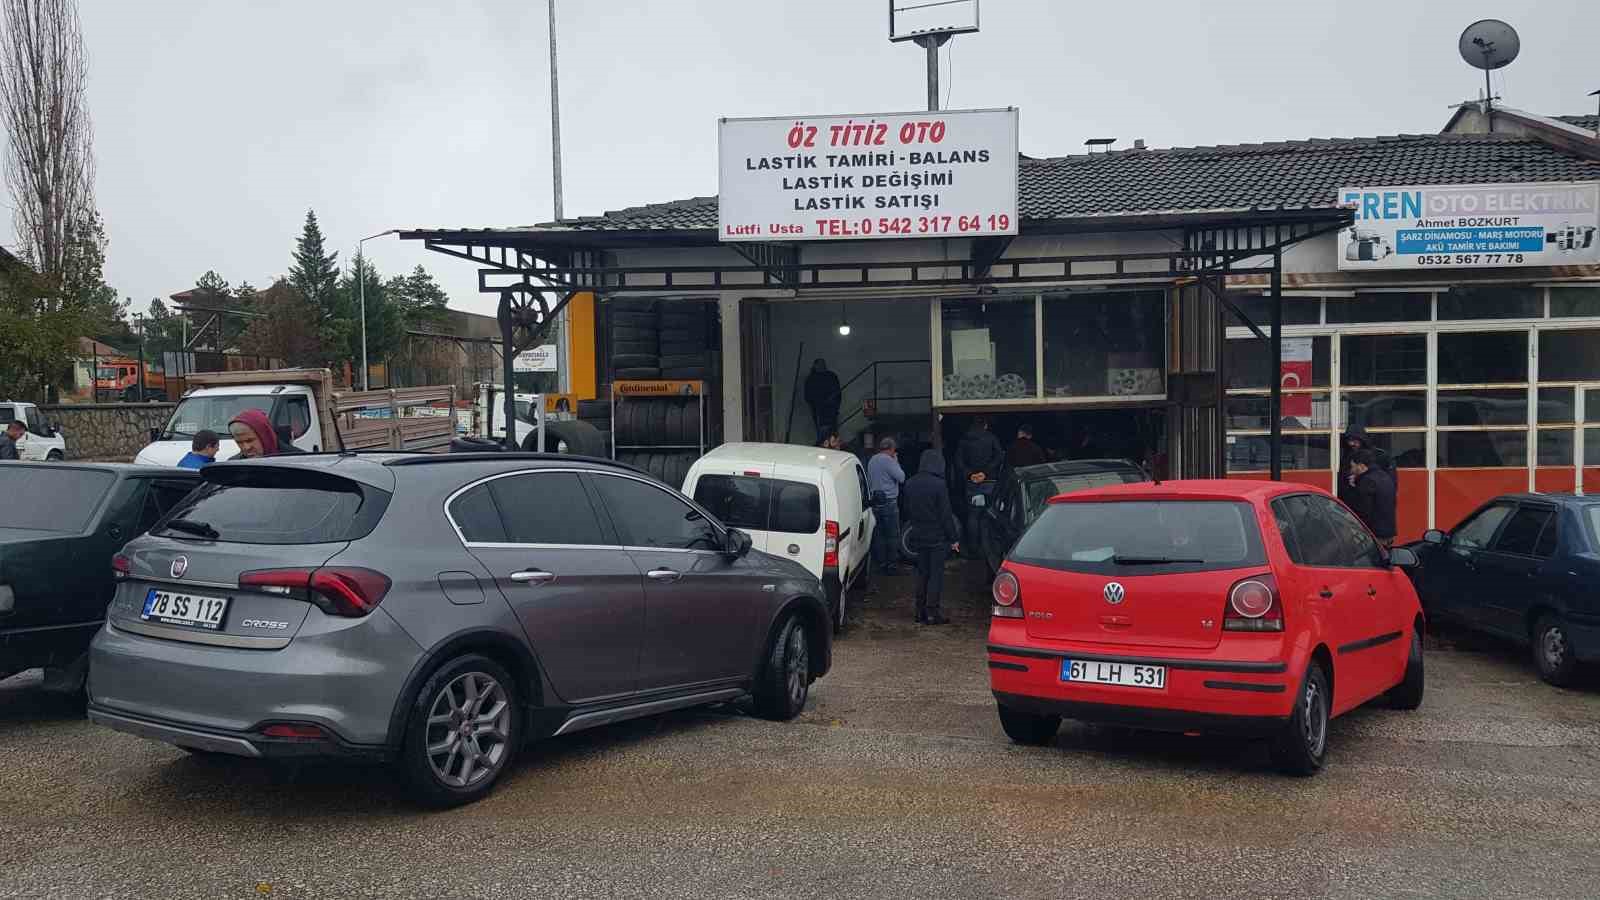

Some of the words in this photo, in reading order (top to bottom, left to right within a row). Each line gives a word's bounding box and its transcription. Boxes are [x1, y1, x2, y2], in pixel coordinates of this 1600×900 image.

[787, 121, 818, 148] ÖZ
[829, 120, 888, 146] TİTİZ
[899, 120, 946, 144] OTO
[746, 153, 817, 170] LASTİK
[782, 173, 854, 190] LASTİK
[862, 169, 953, 189] DEĞİŞİMİ
[794, 194, 866, 211] LASTİK
[875, 194, 939, 210] SATIŞI
[1430, 194, 1478, 213] OTO
[769, 223, 804, 234] Usta
[879, 218, 912, 234] 542
[918, 216, 952, 232] 317
[958, 215, 980, 232] 64
[987, 214, 1009, 231] 19
[1416, 218, 1455, 228] Ahmet
[1458, 216, 1520, 227] BOZKURT
[1476, 242, 1487, 250] VE
[1417, 255, 1451, 265] 0532
[1456, 254, 1480, 264] 567
[1486, 254, 1503, 263] 77
[1507, 253, 1524, 263] 78
[152, 591, 169, 613] 78
[172, 596, 190, 616] SS
[196, 599, 223, 621] 112
[242, 618, 289, 631] CROSS
[1070, 662, 1086, 679] 61
[1097, 663, 1121, 682] LH
[1134, 666, 1163, 686] 531
